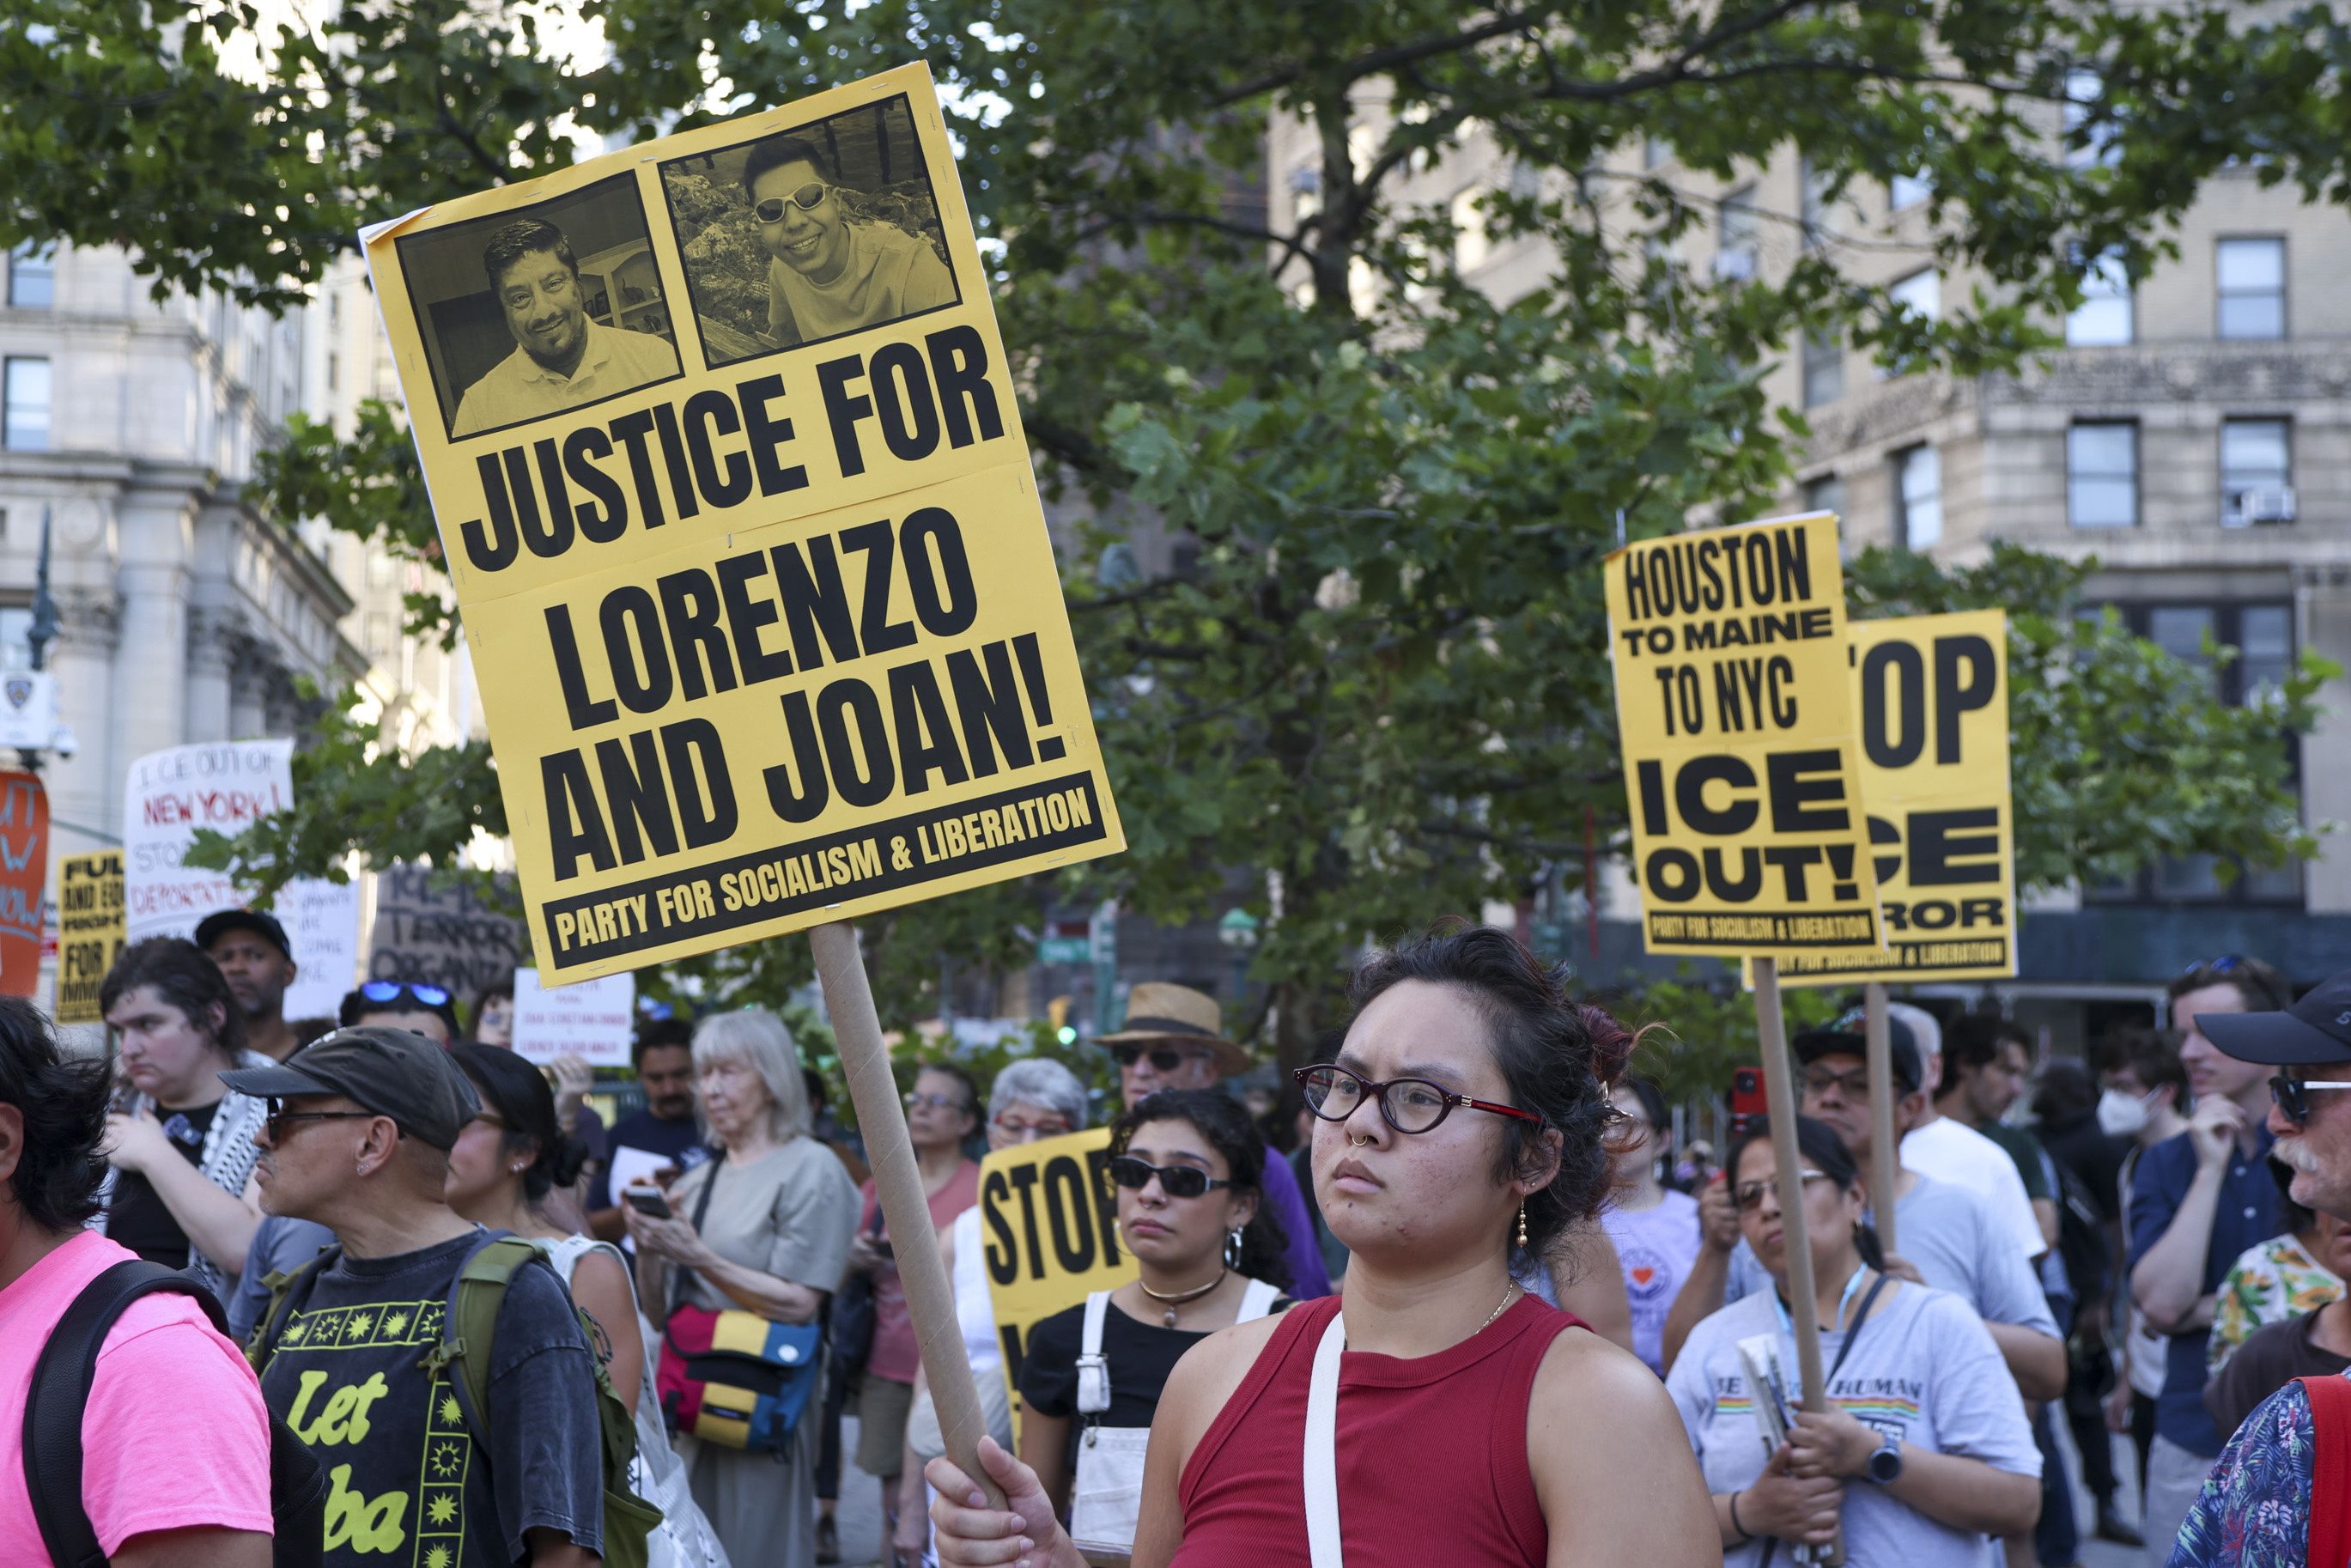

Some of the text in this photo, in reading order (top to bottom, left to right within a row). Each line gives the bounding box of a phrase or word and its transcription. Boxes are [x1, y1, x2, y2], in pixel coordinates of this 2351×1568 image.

[460, 325, 1005, 572] JUSTICE FOR
[1625, 526, 1811, 620] HOUSTON
[544, 507, 977, 731] LORENZO
[1621, 607, 1832, 656] TO MAINE
[1655, 655, 1797, 736] TO NYC
[540, 632, 1066, 882] AND JOAN!
[1637, 749, 1851, 836] ICE
[555, 894, 647, 951] PARTY
[656, 879, 716, 927] FOR
[720, 837, 884, 912] SOCIALISM
[890, 836, 914, 872] &
[916, 787, 1092, 865] LIBERATION
[1646, 844, 1860, 903] OUT!
[287, 1370, 388, 1445] Let
